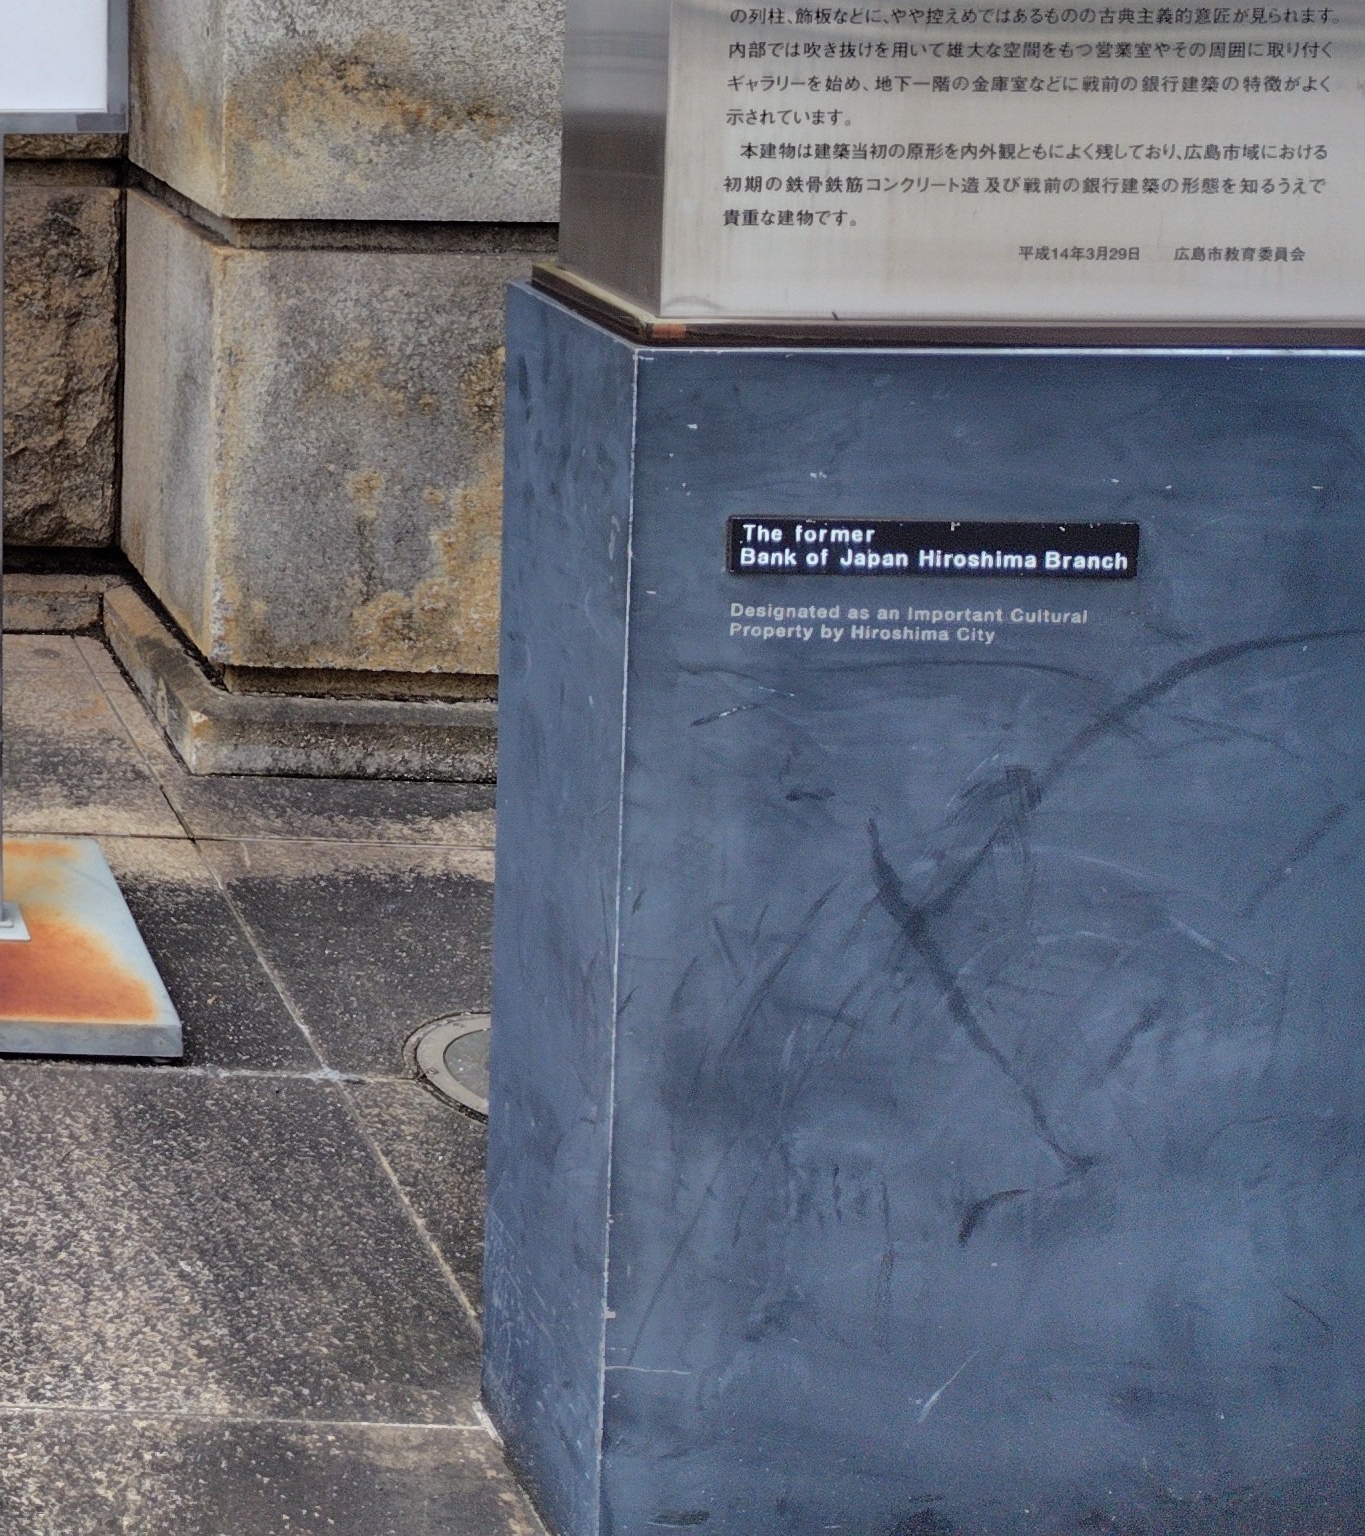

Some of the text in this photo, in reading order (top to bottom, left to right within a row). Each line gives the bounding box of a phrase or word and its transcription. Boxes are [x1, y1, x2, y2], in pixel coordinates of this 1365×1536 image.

[725, 108, 853, 127] 示されています。
[722, 209, 858, 227] 貴重な建物です。
[1018, 245, 1306, 263] 平成14年3月29日 広島市教育委員会
[743, 524, 876, 544] The former
[740, 547, 1129, 571] Bank of Japan Hiroshima Branch
[730, 602, 1088, 626] Designated as an Important Cultural
[729, 623, 996, 645] Property by Hiroshima City
